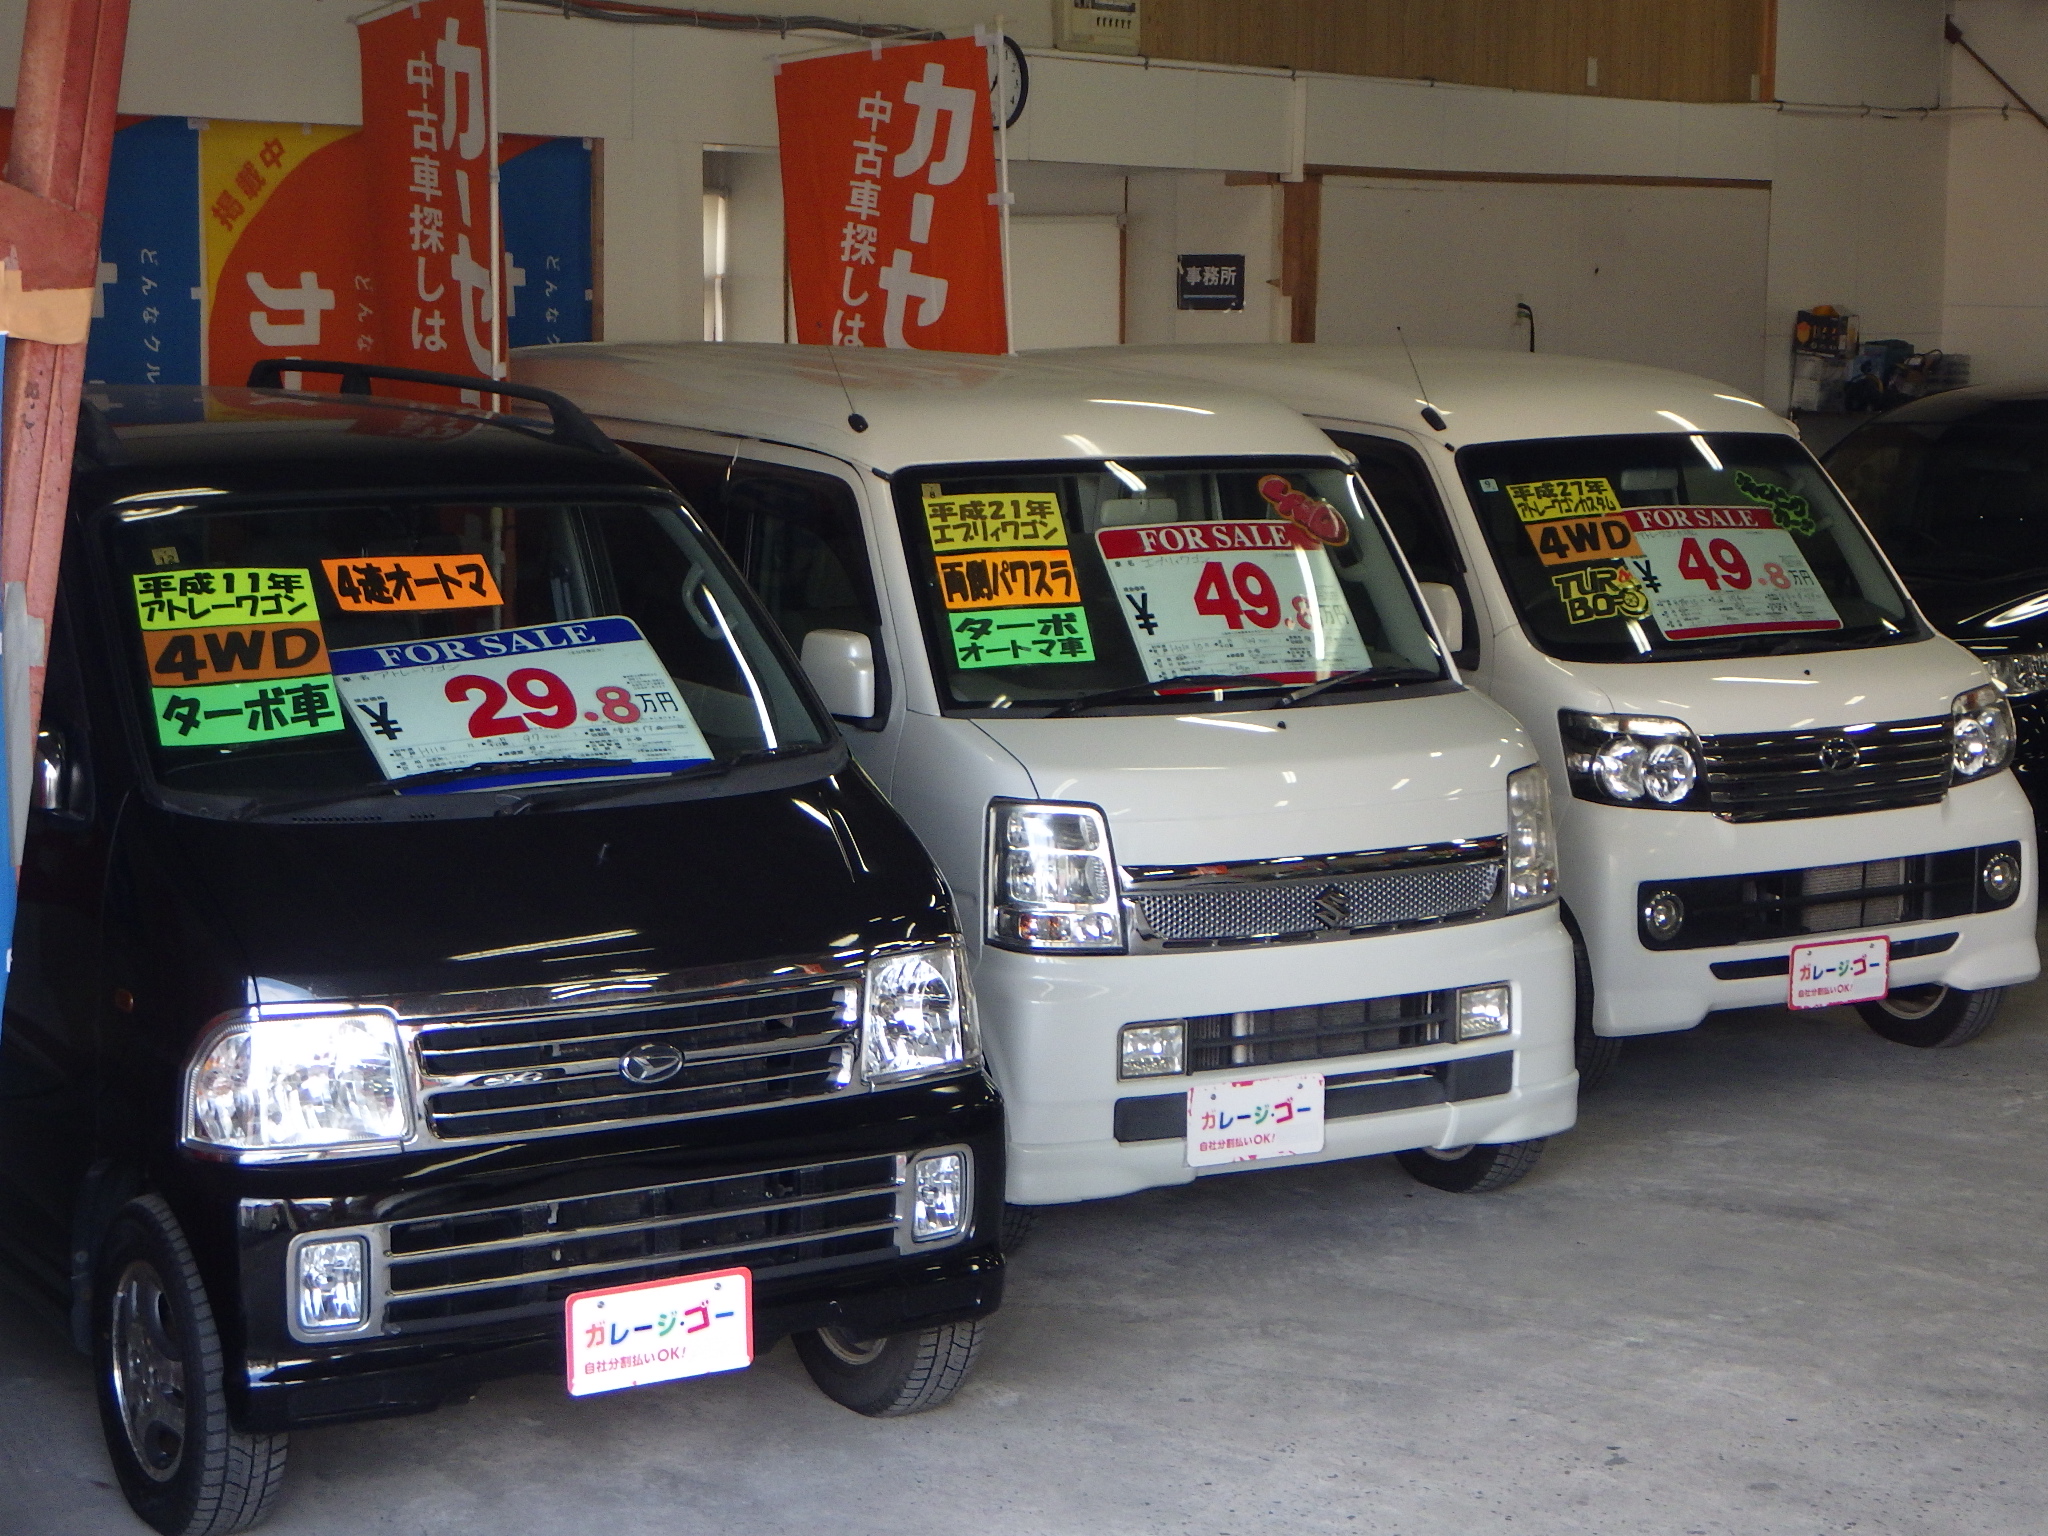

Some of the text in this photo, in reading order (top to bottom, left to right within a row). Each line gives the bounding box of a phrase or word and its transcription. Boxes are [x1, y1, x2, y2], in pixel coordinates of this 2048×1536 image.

[211, 137, 286, 232] 掲載中
[406, 51, 448, 352] 中古車探しは
[437, 17, 507, 404] カーセ
[879, 63, 976, 348] カーセ
[832, 91, 892, 346] 中古車探しは
[1185, 265, 1237, 286] 事務所
[1510, 480, 1609, 501] 平成27年
[928, 500, 1055, 522] 平成21年
[1638, 509, 1759, 530] FOR SALE
[1137, 525, 1292, 553] FOR SALE
[1539, 520, 1632, 560] 4WD
[138, 572, 305, 598] 平成11年
[336, 561, 488, 605] 4速オートマ
[141, 593, 308, 622] アトレーワゴン
[955, 612, 1078, 640] ターボ
[155, 628, 320, 681] 4WD
[377, 624, 596, 668] FOR SALE
[958, 636, 1087, 662] オートマ車
[162, 683, 335, 736] ターボ車
[1800, 954, 1880, 980] ガレージ・ゴー
[1202, 1097, 1311, 1130] ガレージ・ゴー
[585, 1300, 734, 1348] ガレージ・ゴー
[584, 1347, 687, 1375] 自社分割払いOK!
